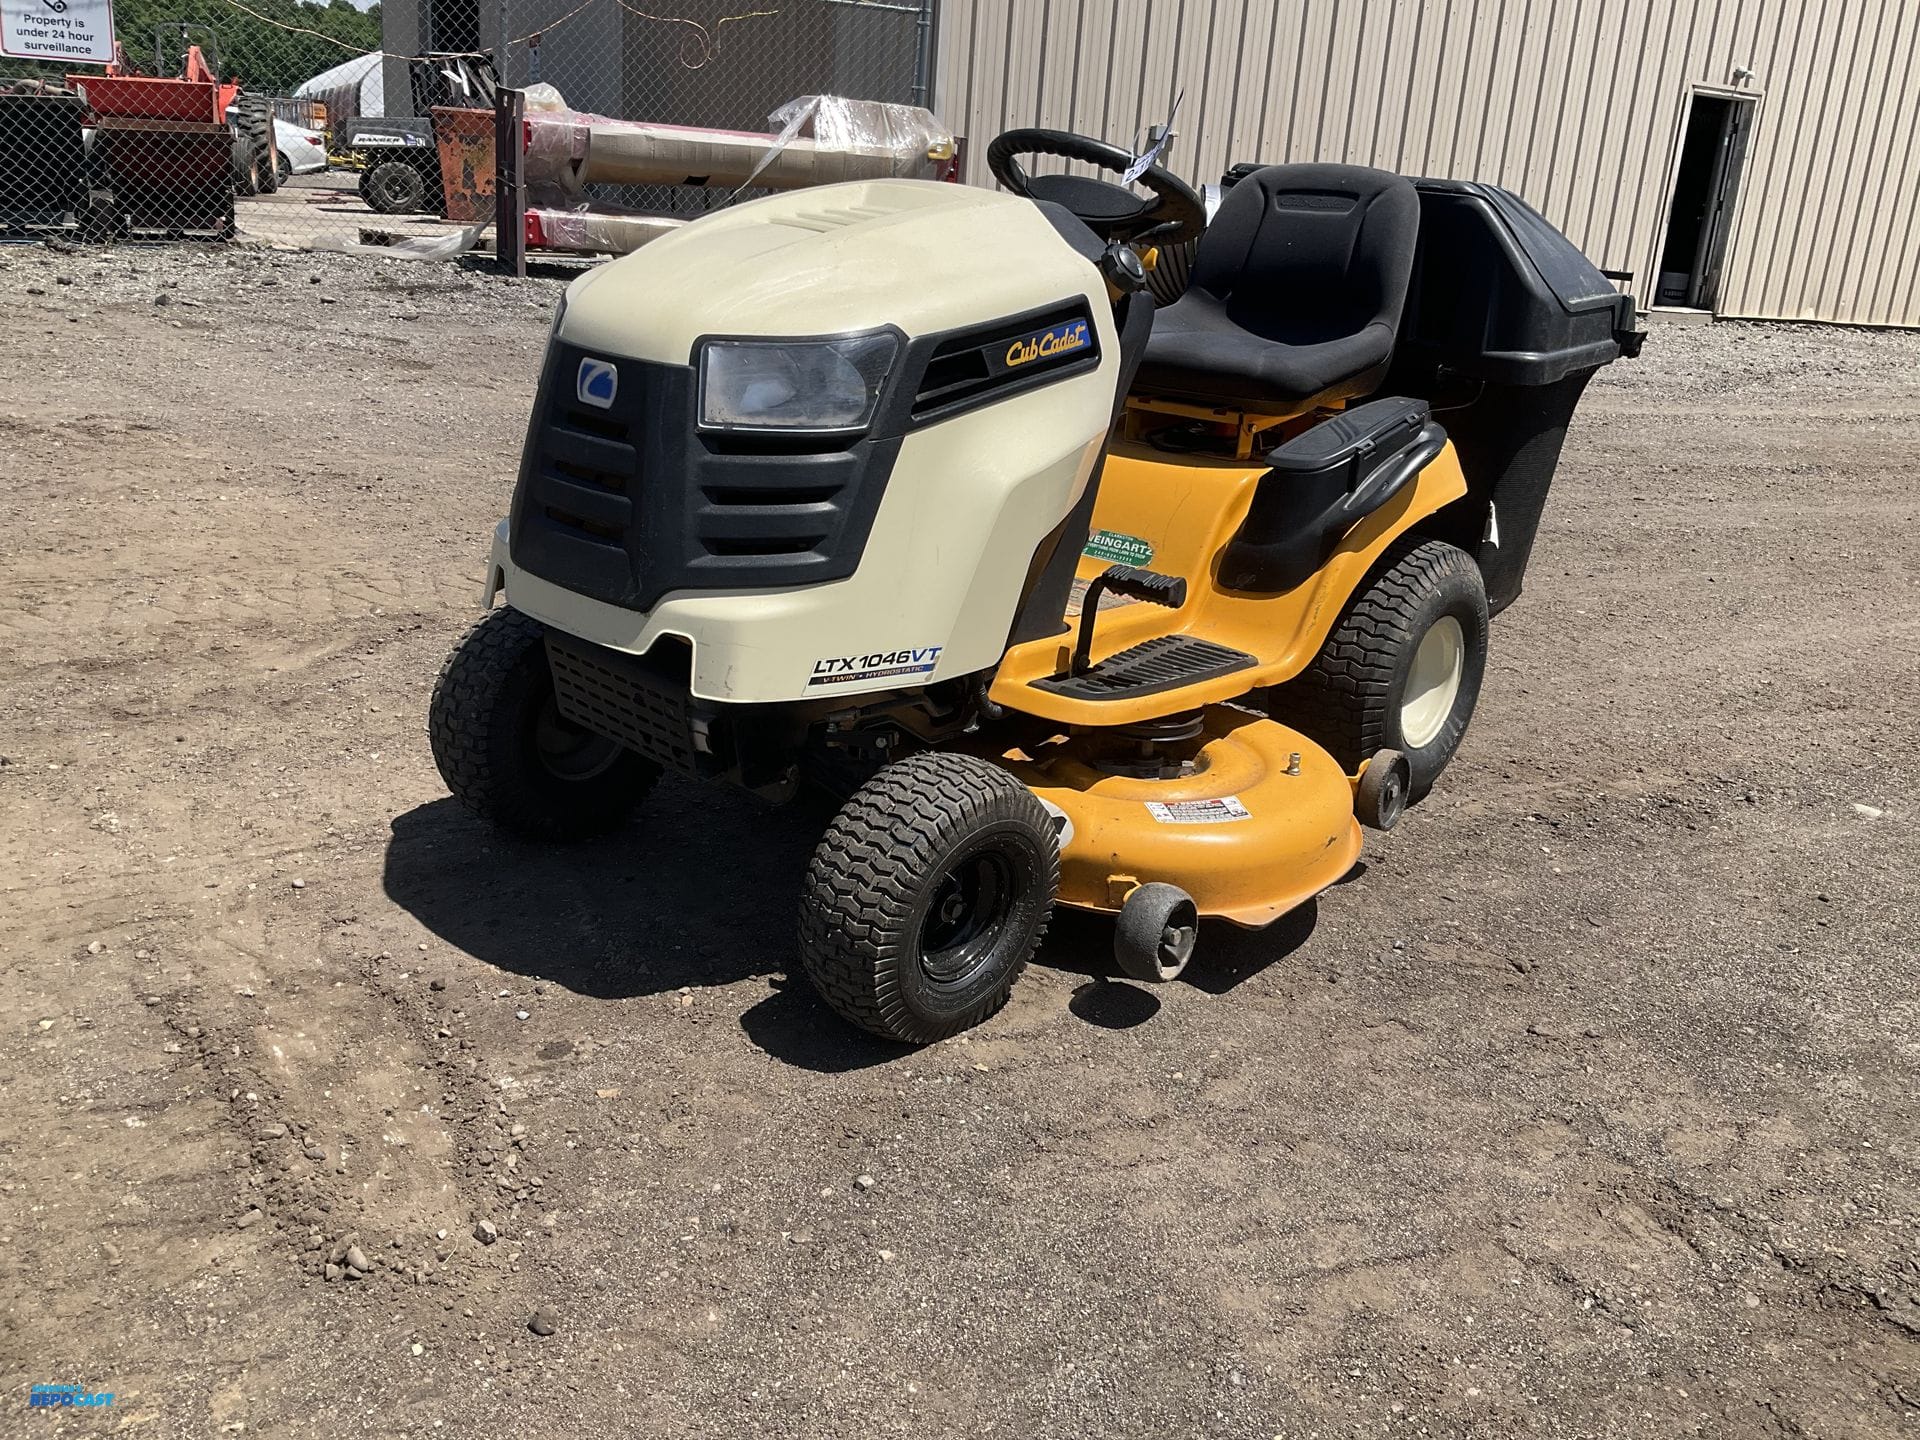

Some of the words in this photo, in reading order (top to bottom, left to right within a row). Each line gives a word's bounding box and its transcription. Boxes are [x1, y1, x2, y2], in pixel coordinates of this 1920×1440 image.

[23, 14, 72, 29] Property
[75, 18, 85, 28] is
[16, 28, 48, 38] under
[52, 30, 65, 39] 24
[68, 31, 94, 42] hour
[24, 41, 92, 55] surveillance
[1006, 337, 1038, 367] Cub
[1039, 325, 1086, 357] Cadet
[814, 657, 857, 674] LTX
[859, 647, 943, 669] 1046VT
[865, 665, 925, 678] HYDROSTATIC
